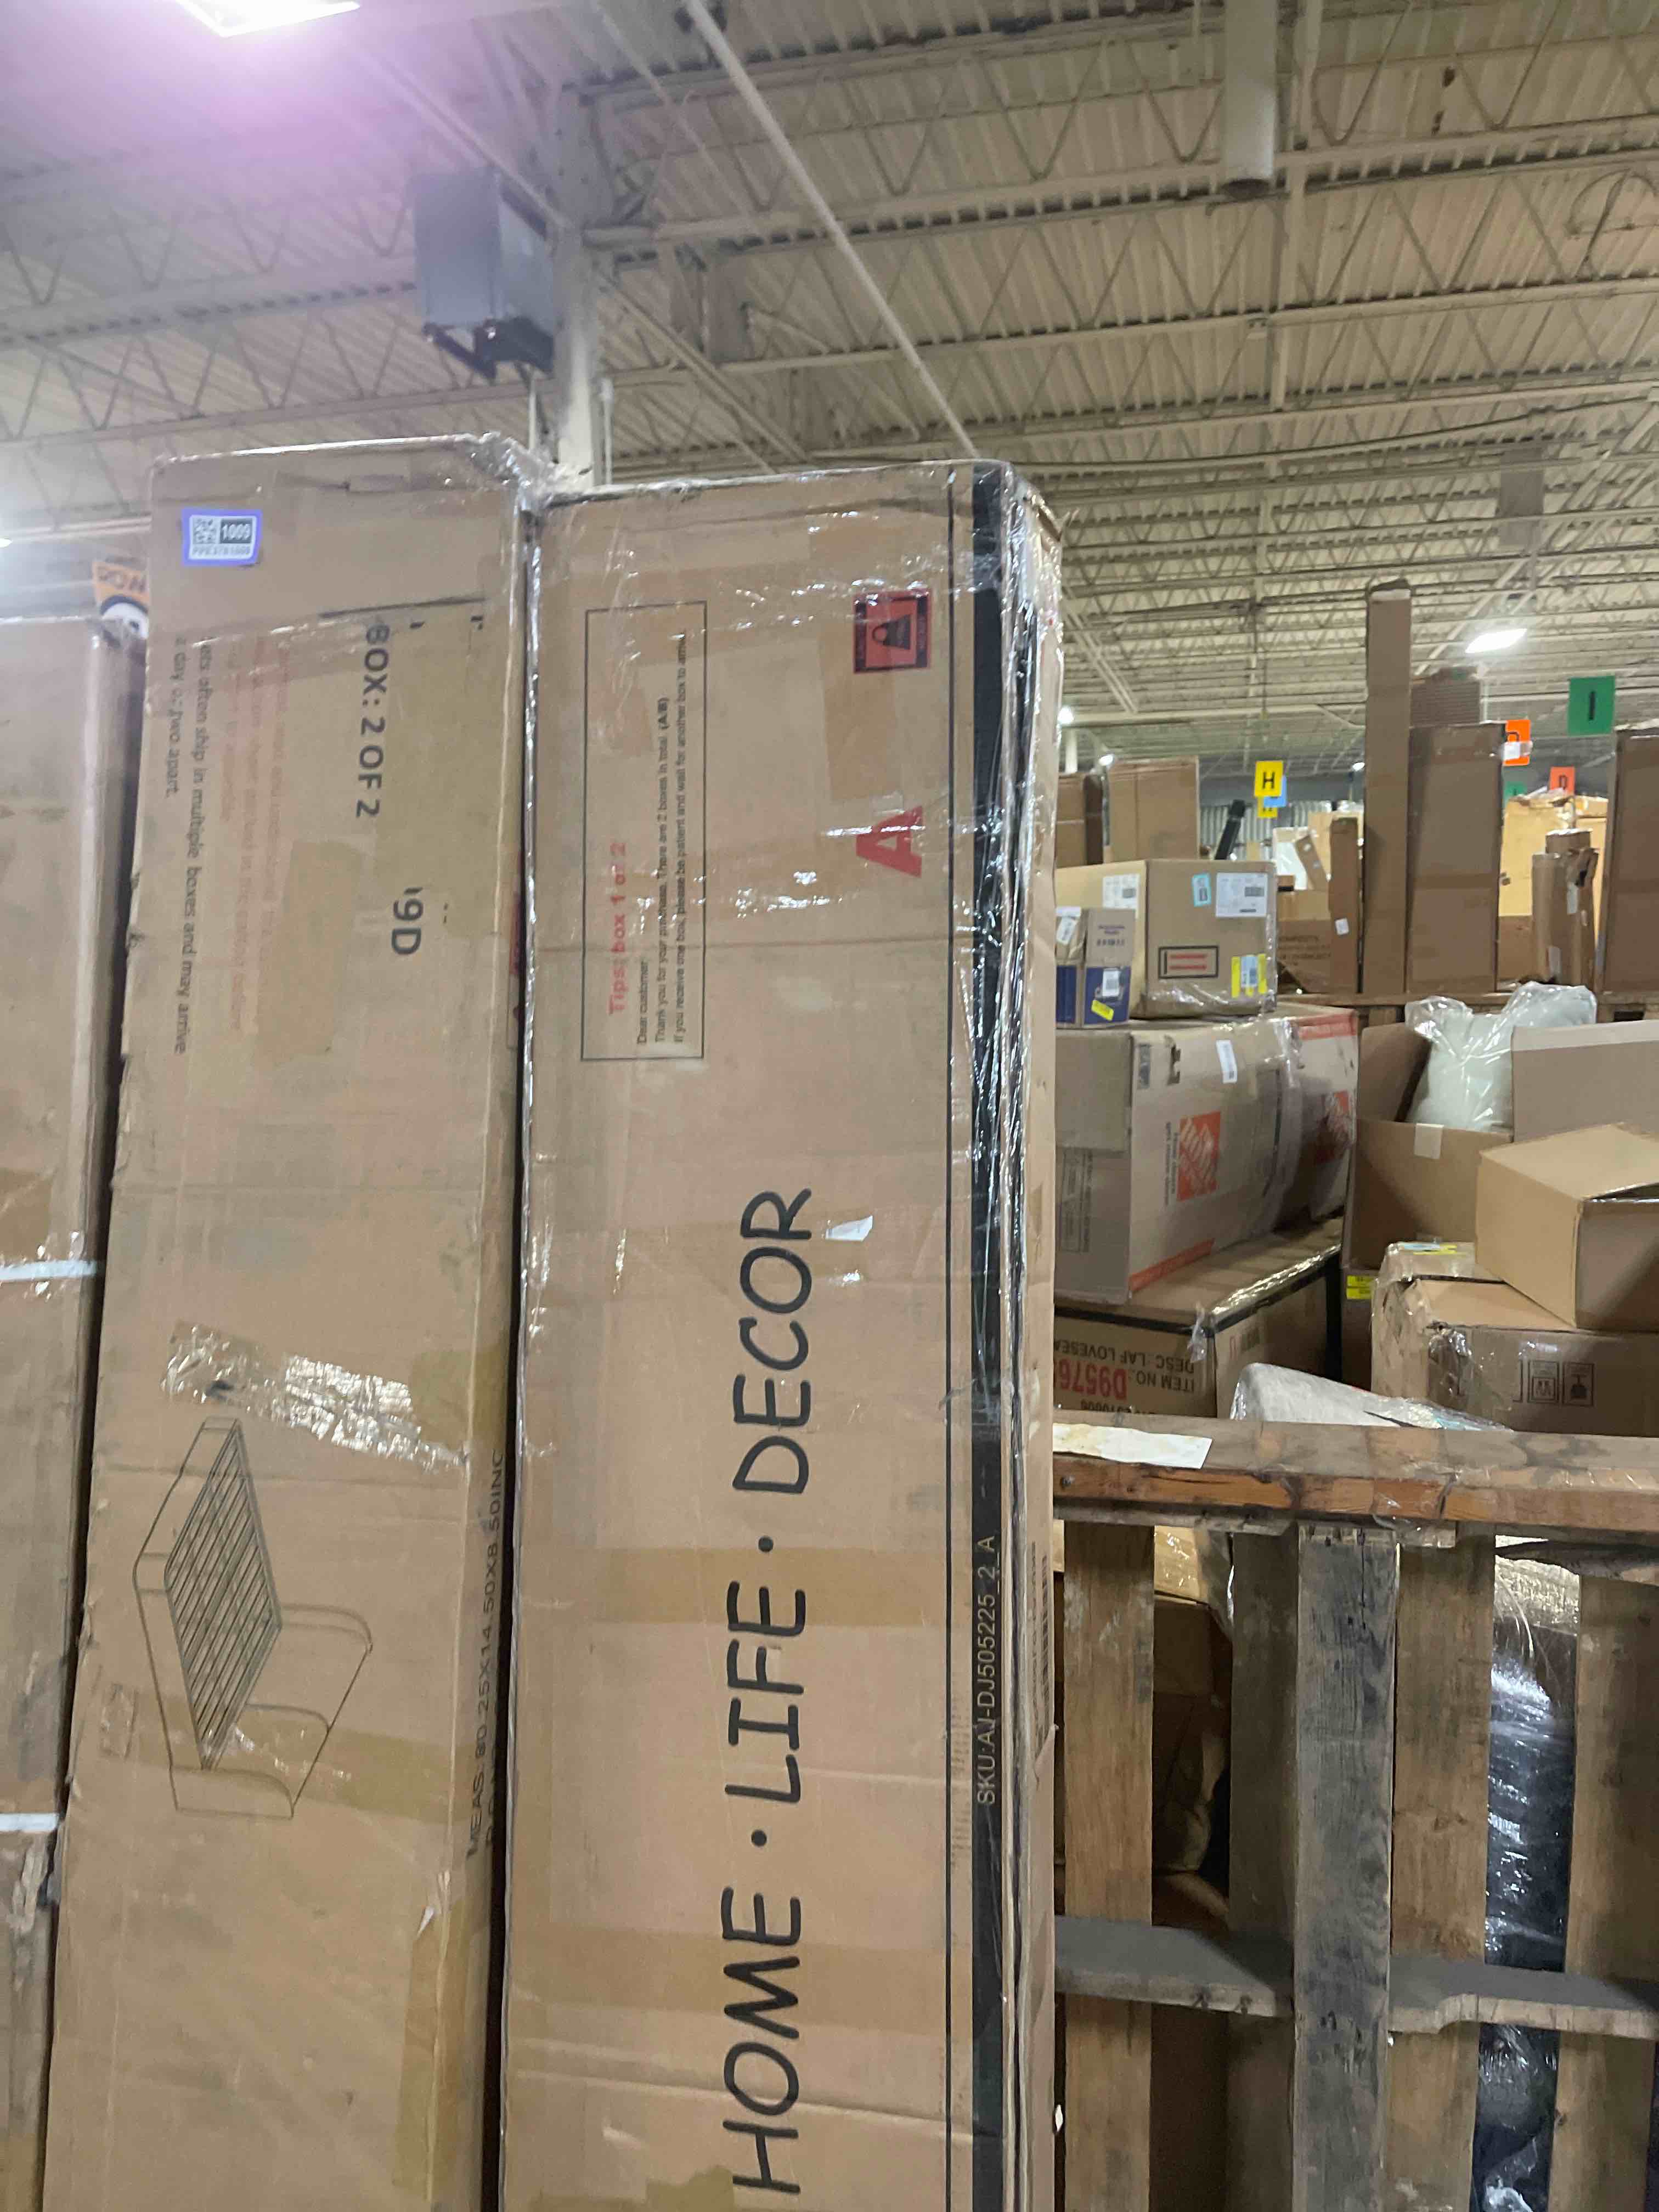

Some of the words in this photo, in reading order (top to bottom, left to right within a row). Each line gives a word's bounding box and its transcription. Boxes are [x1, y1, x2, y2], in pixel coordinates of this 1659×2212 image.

[170, 652, 190, 682] day
[361, 624, 390, 707] BOX:
[198, 677, 214, 723] often
[676, 681, 686, 701] box
[360, 716, 386, 735] 2
[193, 727, 210, 760] ship
[166, 747, 182, 799] apart.
[193, 768, 208, 783] in
[358, 744, 384, 789] OF
[676, 768, 686, 791] wait
[1262, 771, 1275, 789] H
[356, 799, 381, 818] 2
[657, 777, 668, 810] boxes
[675, 795, 686, 816] and
[186, 789, 207, 859] multiple
[675, 819, 687, 856] patient
[610, 842, 626, 856] 2
[855, 805, 922, 878] A
[675, 860, 685, 874] be
[185, 866, 203, 918] boxes
[610, 895, 626, 905] 1
[675, 877, 686, 915] please
[390, 887, 424, 956] 9D
[610, 914, 626, 953] box
[181, 923, 198, 956] and
[658, 941, 669, 963] your
[176, 961, 194, 998] may
[657, 966, 667, 981] for
[675, 968, 685, 1009] receive
[657, 985, 668, 1006] you
[174, 1003, 191, 1054] arrive
[637, 1017, 648, 1045] Dear
[656, 1009, 667, 1042] Thank
[675, 1012, 686, 1033] you
[732, 1190, 811, 1493] DECOR
[1120, 1350, 1146, 1367] LAF
[1053, 1358, 1127, 1400] D9576
[1161, 1373, 1195, 1392] ITEM
[725, 1582, 805, 1802] LIFE
[721, 1888, 800, 2193] HOME
